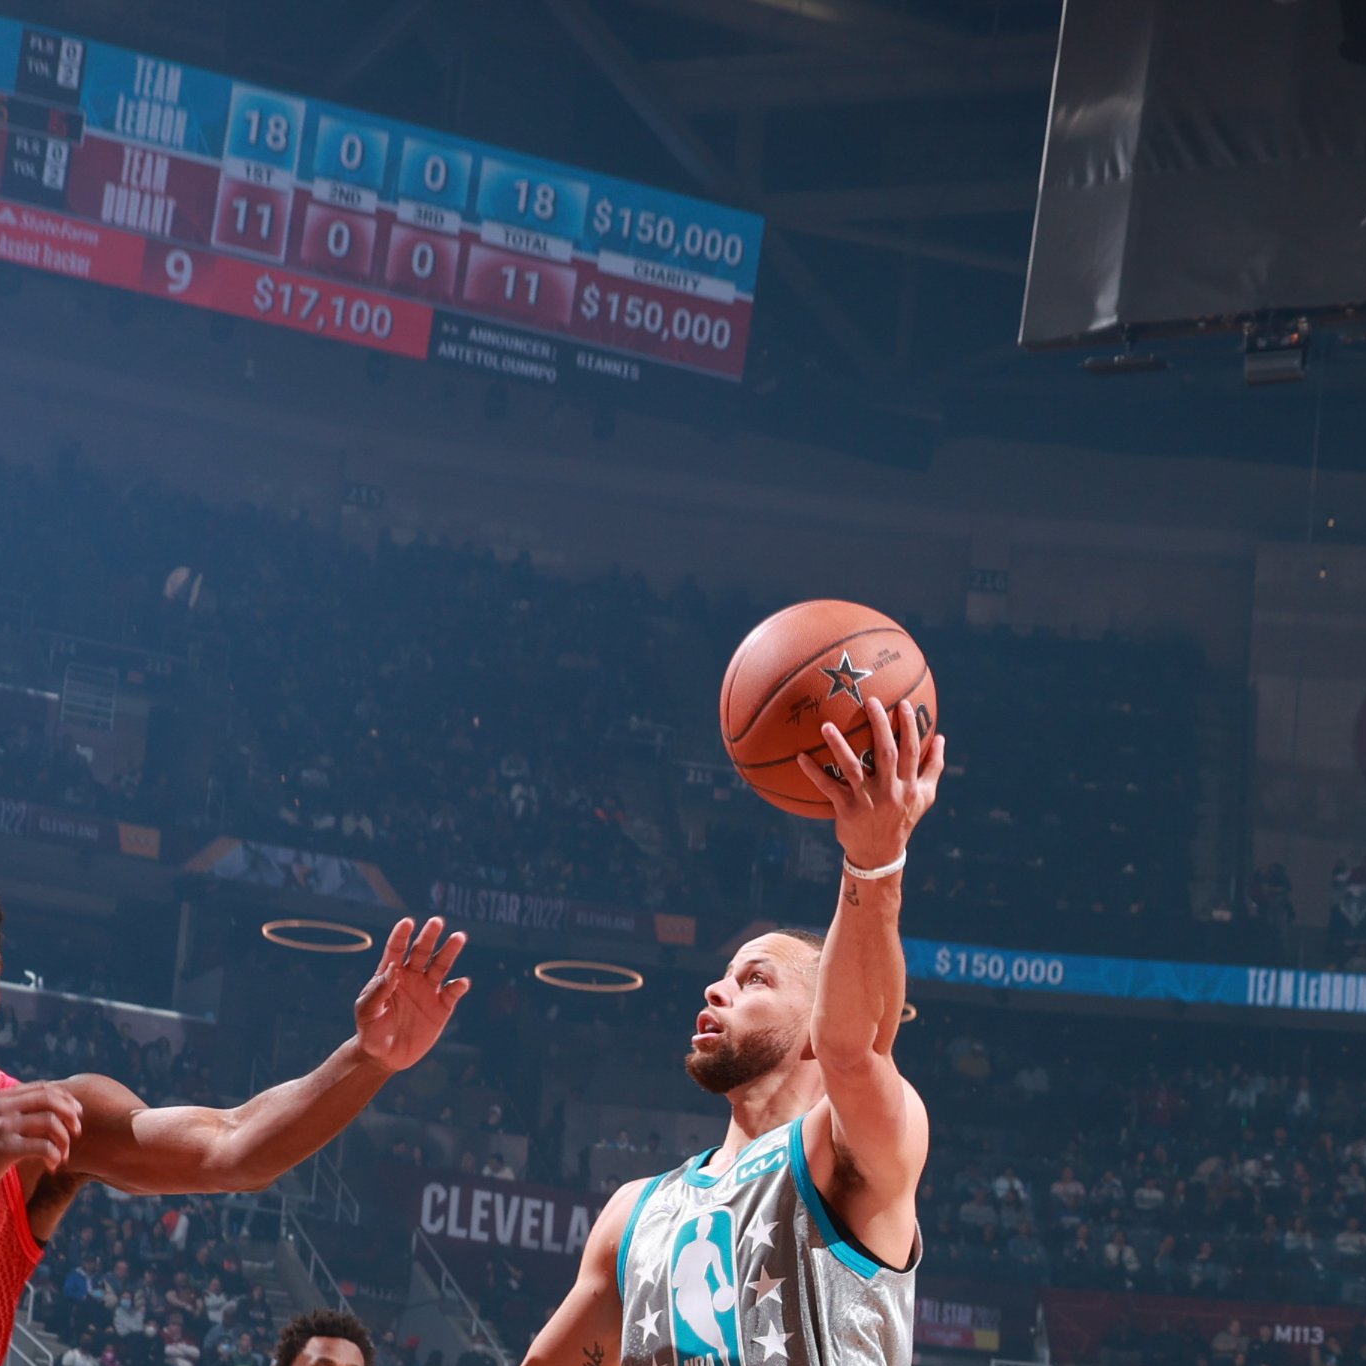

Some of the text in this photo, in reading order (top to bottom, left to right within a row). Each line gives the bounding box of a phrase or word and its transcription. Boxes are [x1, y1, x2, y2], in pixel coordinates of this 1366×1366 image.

[134, 55, 183, 105] TEAM
[245, 109, 289, 151] 18
[120, 147, 170, 194] TEAM
[340, 133, 363, 170] 0
[245, 164, 273, 185] 1ST
[424, 155, 447, 192] 0
[101, 182, 176, 238] DURANT
[328, 186, 362, 206] 2ND
[413, 205, 444, 226] 3RD
[513, 178, 556, 220] 18
[232, 197, 272, 241] 11
[327, 220, 350, 258] 0
[504, 228, 549, 252] TOTAL
[592, 197, 744, 267] $150,000
[164, 250, 193, 293] 9
[411, 241, 434, 279] 0
[633, 262, 702, 291] CHARITY
[253, 273, 393, 339] $17,100
[501, 264, 540, 306] 11
[580, 282, 731, 350] $150,000
[576, 352, 641, 382] GIANNIS
[934, 947, 1064, 986] $150,000
[1247, 968, 1294, 1008] TEAM
[421, 1182, 597, 1256] CLEVELA
[1274, 1325, 1325, 1345] M113
